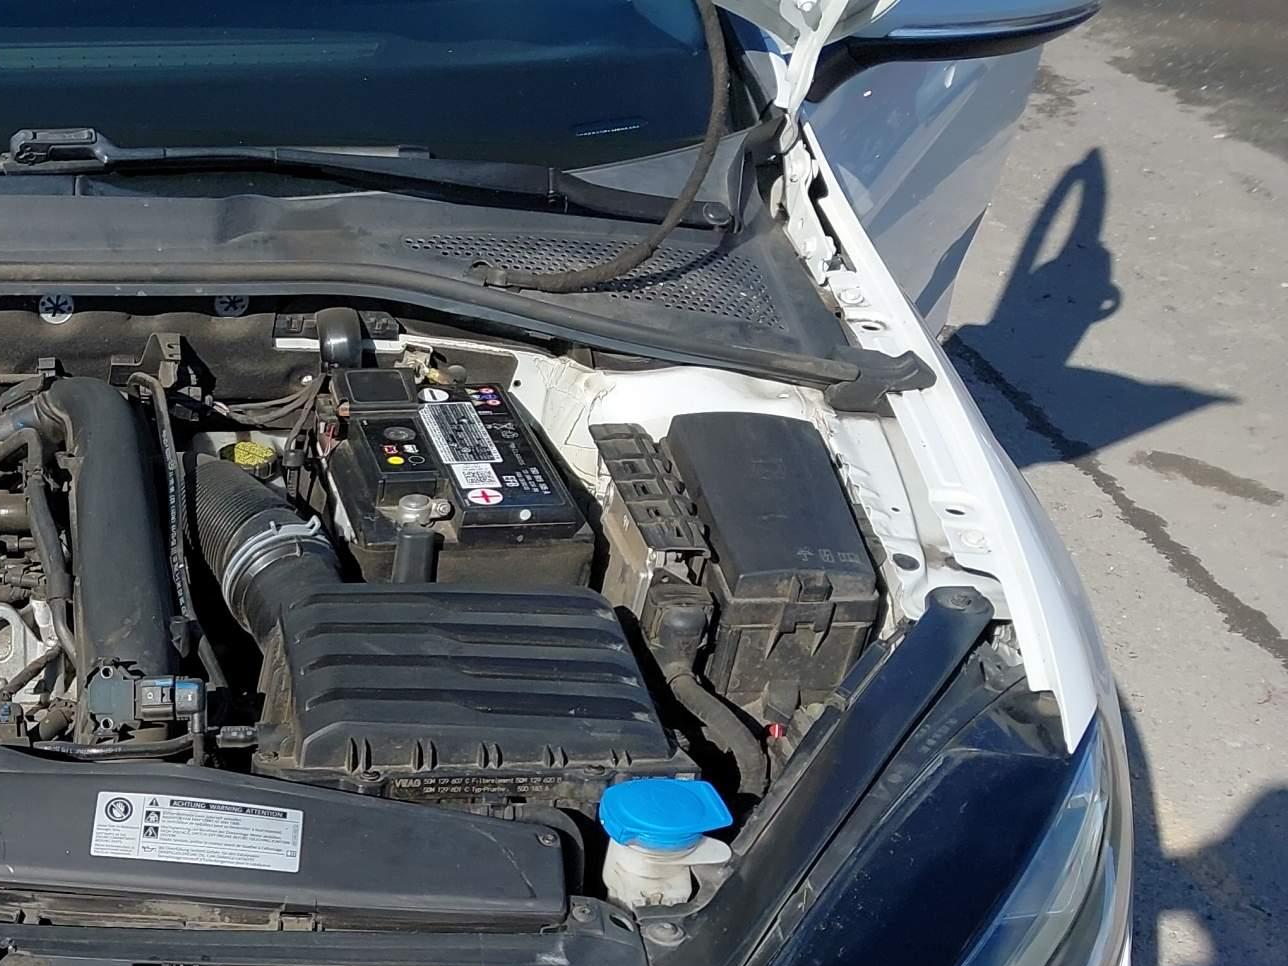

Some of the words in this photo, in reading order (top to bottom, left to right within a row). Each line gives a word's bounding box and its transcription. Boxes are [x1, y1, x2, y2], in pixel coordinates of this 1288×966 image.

[172, 799, 207, 809] ACHTUNG
[209, 803, 243, 813] WARNING
[245, 807, 284, 818] ATTENTION
